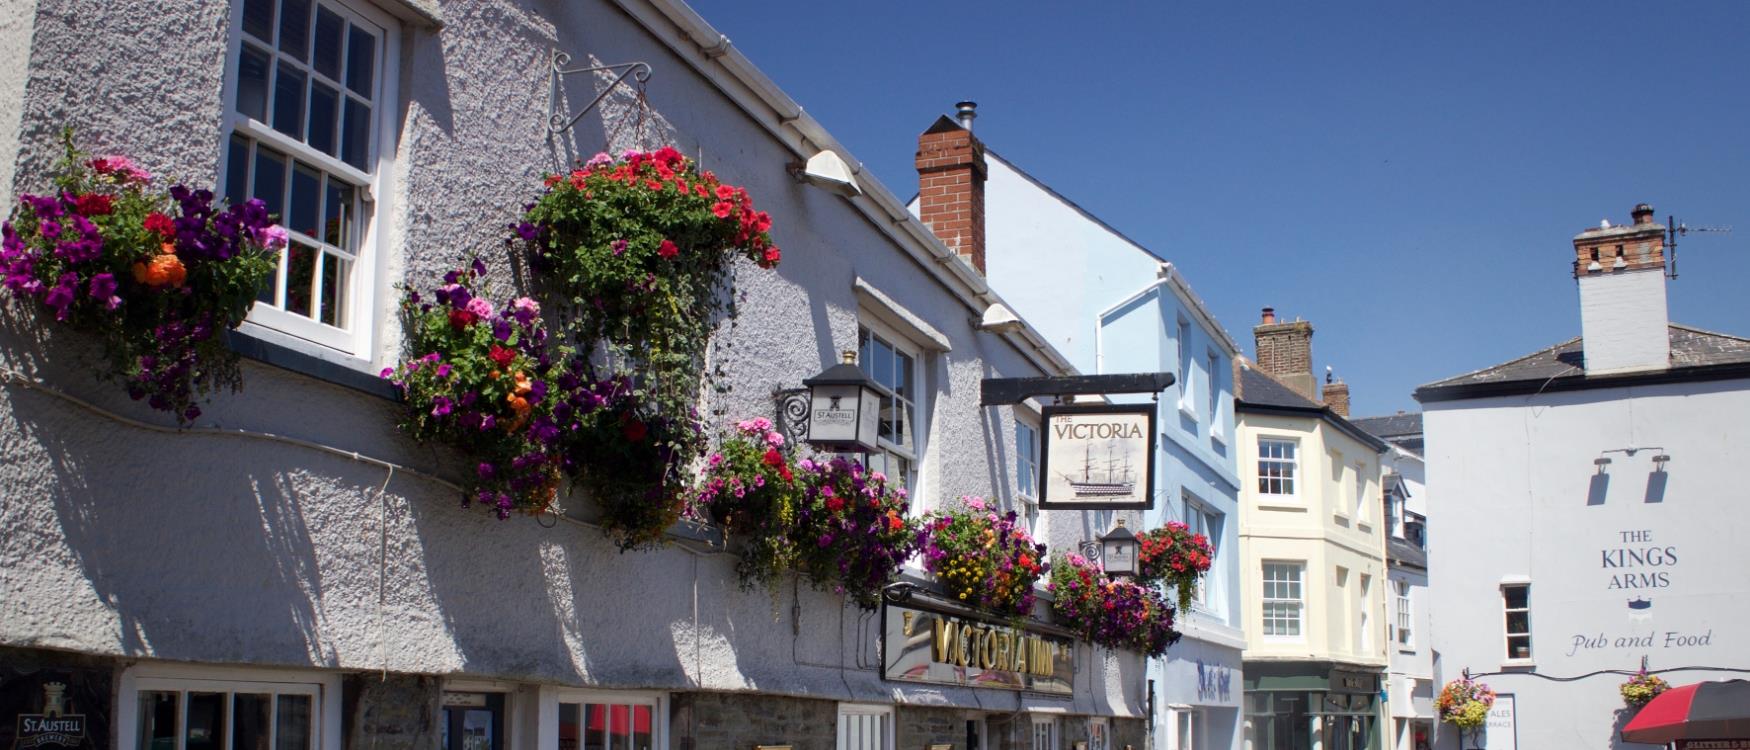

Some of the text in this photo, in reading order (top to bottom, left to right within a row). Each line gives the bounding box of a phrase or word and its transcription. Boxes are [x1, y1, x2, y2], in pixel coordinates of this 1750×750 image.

[1054, 422, 1143, 440] VICTORIA
[1619, 530, 1653, 543] THE
[1601, 546, 1678, 568] KINGS
[1608, 571, 1670, 590] ARMS
[932, 615, 1054, 676] VICTORIA INN
[1566, 629, 1713, 657] Pub and Food
[1490, 710, 1511, 718] ALES
